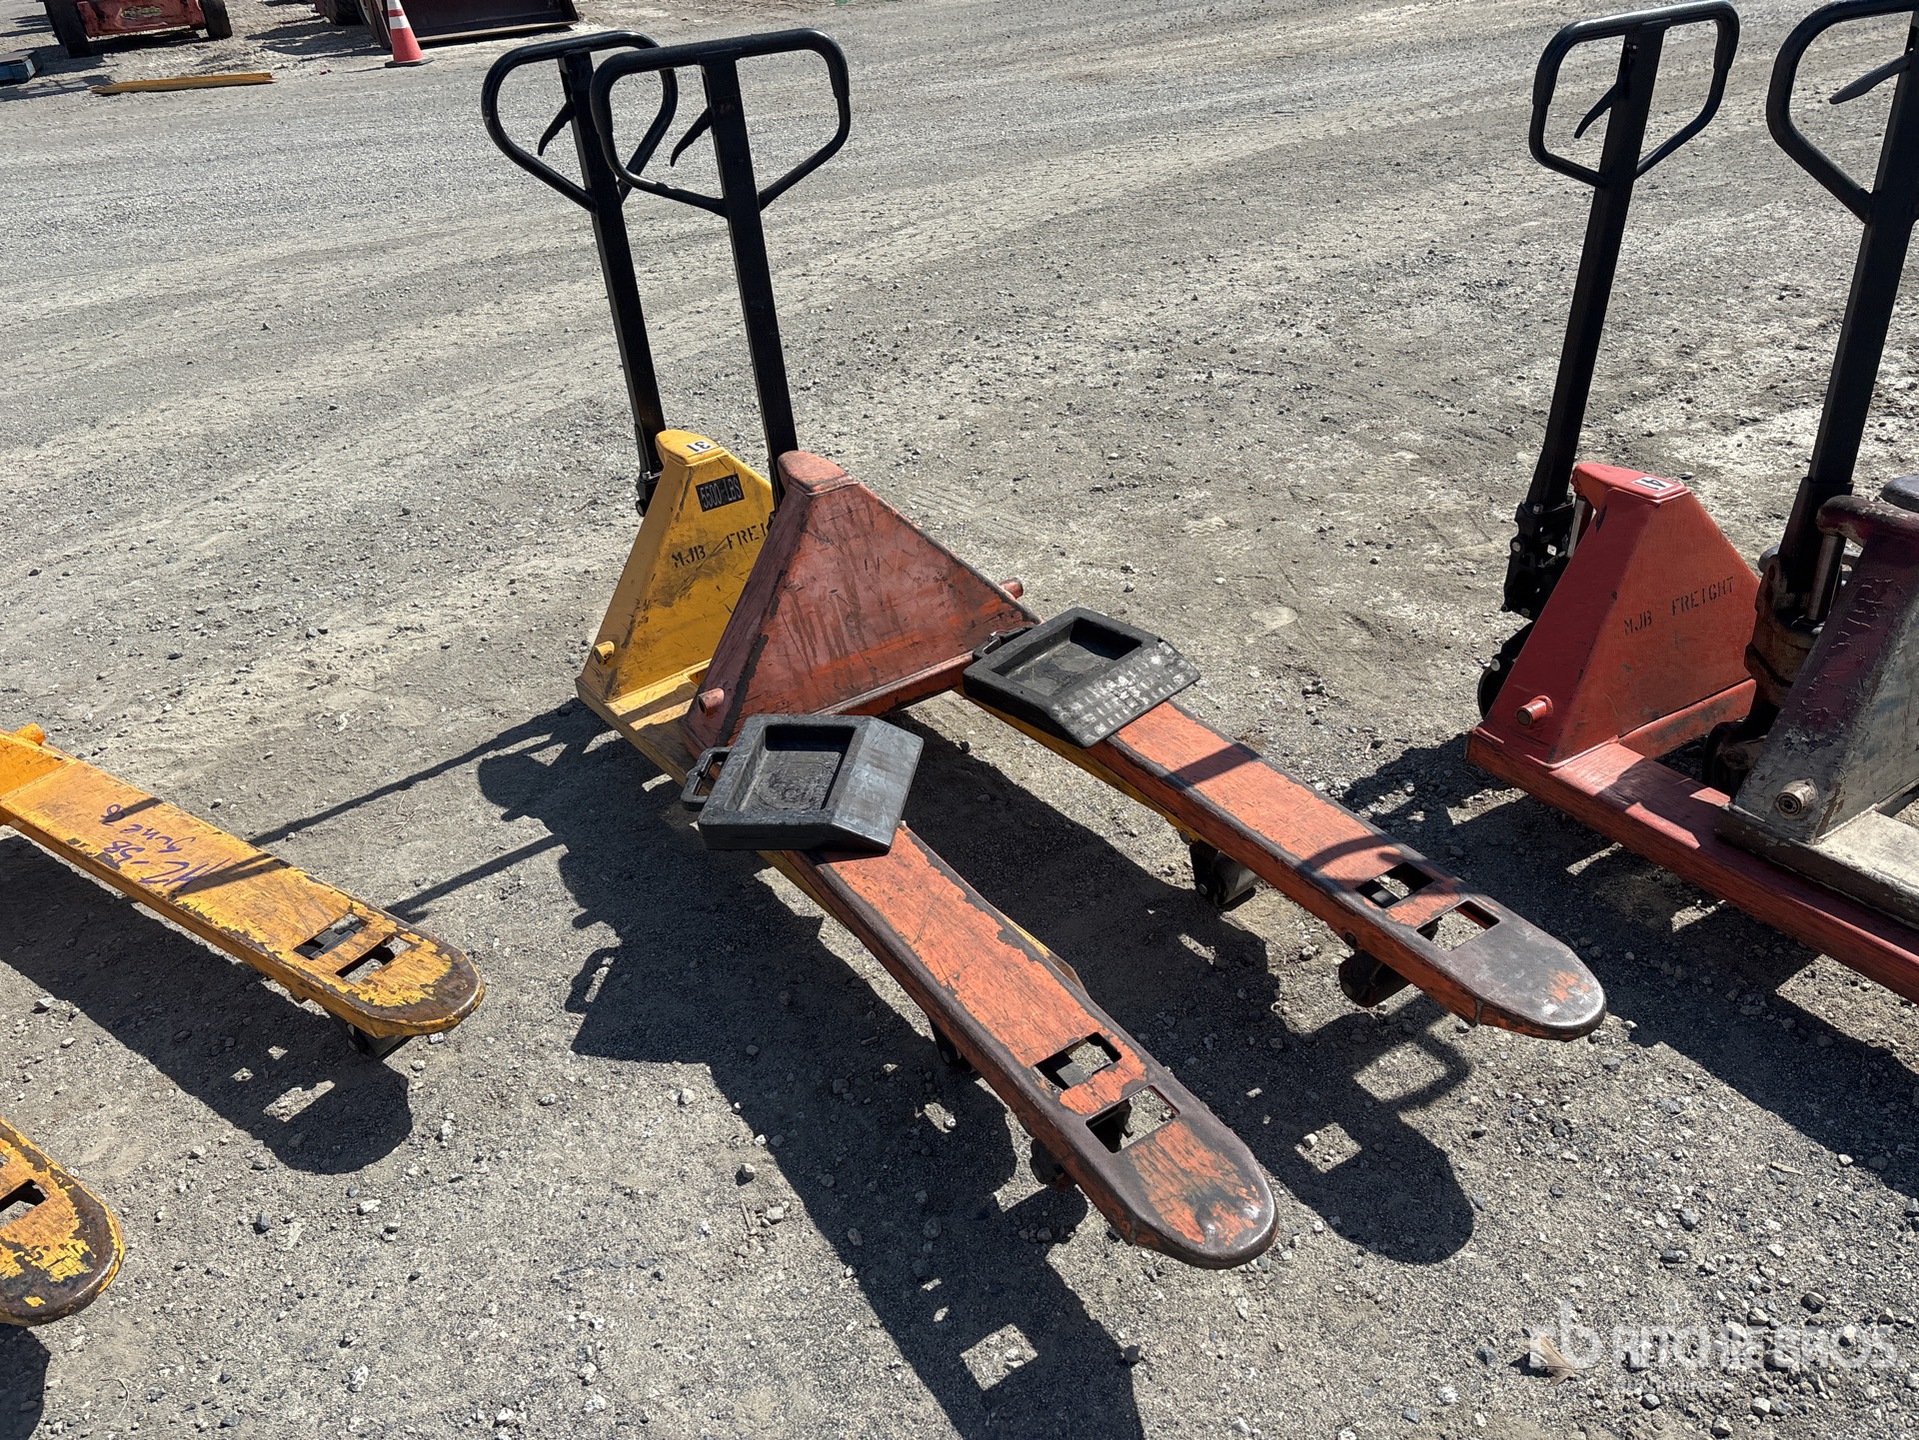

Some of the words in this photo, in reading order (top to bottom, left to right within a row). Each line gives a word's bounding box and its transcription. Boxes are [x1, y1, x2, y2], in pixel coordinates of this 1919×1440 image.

[671, 545, 706, 569] MJB
[726, 522, 770, 549] FREI
[1623, 610, 1653, 635] MJB
[1671, 576, 1734, 616] FREIGHT
